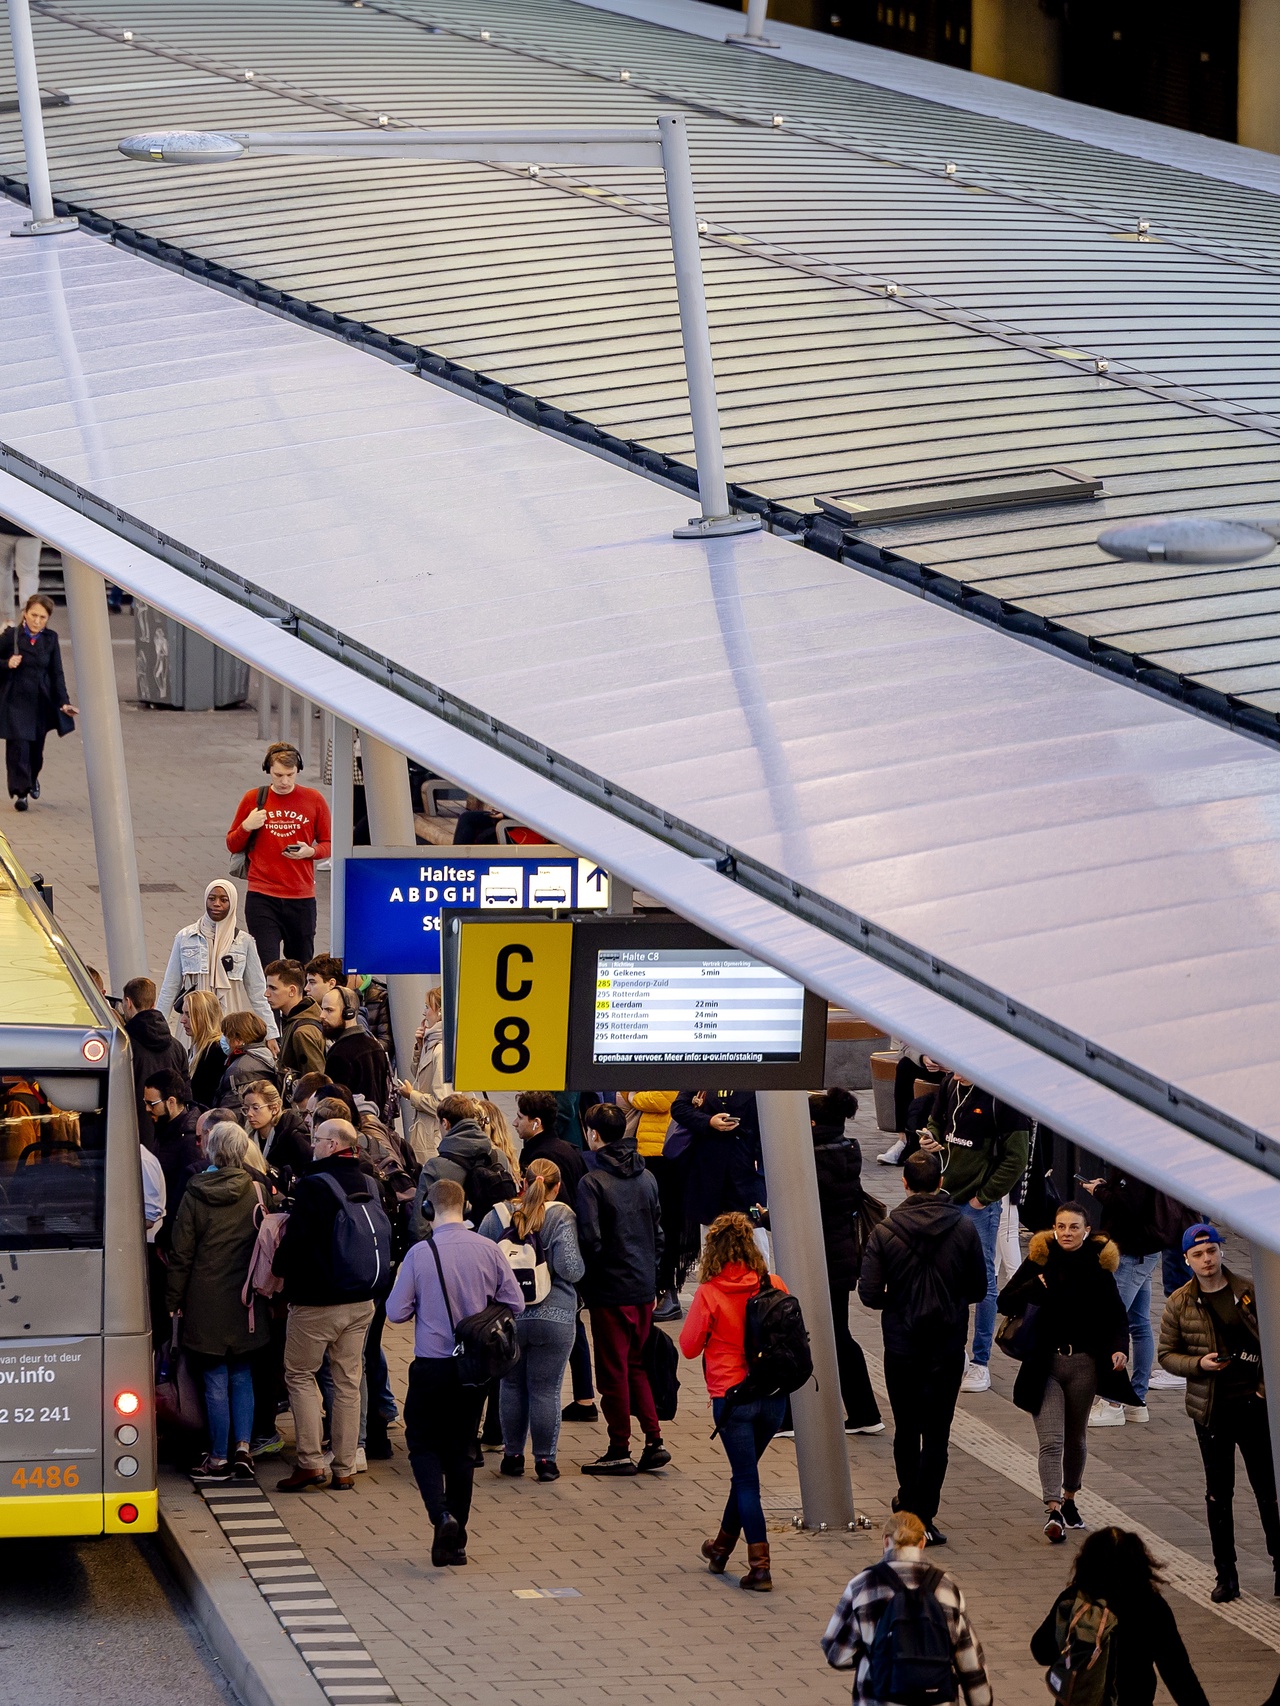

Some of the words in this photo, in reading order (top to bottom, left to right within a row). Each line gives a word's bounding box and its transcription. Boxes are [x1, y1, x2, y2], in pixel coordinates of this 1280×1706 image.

[420, 866, 476, 882] Haltes
[389, 887, 404, 902] A
[408, 887, 420, 902] B
[425, 887, 439, 902] D
[443, 887, 457, 902] G
[462, 887, 475, 902] H
[622, 952, 645, 961] Halte
[647, 952, 660, 961] C8
[496, 943, 533, 1001] C
[612, 979, 669, 988] Papendorp-Zuid
[612, 990, 650, 998] Rotterdam
[596, 1001, 610, 1009] 285
[611, 1001, 643, 1009] Leerdam
[704, 1000, 719, 1008] min
[611, 1011, 649, 1019] Rotterdam
[596, 1022, 609, 1030] 295
[703, 1021, 718, 1029] min
[610, 1032, 648, 1040] Rotterdam
[491, 1016, 530, 1074] 8
[598, 1053, 632, 1063] openbaar
[664, 1053, 683, 1061] Meer
[684, 1052, 702, 1061] info:
[702, 1052, 763, 1062] u-ov.info/staking
[0, 1356, 17, 1364] van
[19, 1355, 41, 1363] deur
[43, 1354, 57, 1363] tot
[59, 1353, 81, 1362] deur
[14, 1408, 35, 1423] 52
[39, 1407, 70, 1422] 241
[11, 1465, 80, 1489] 4486
